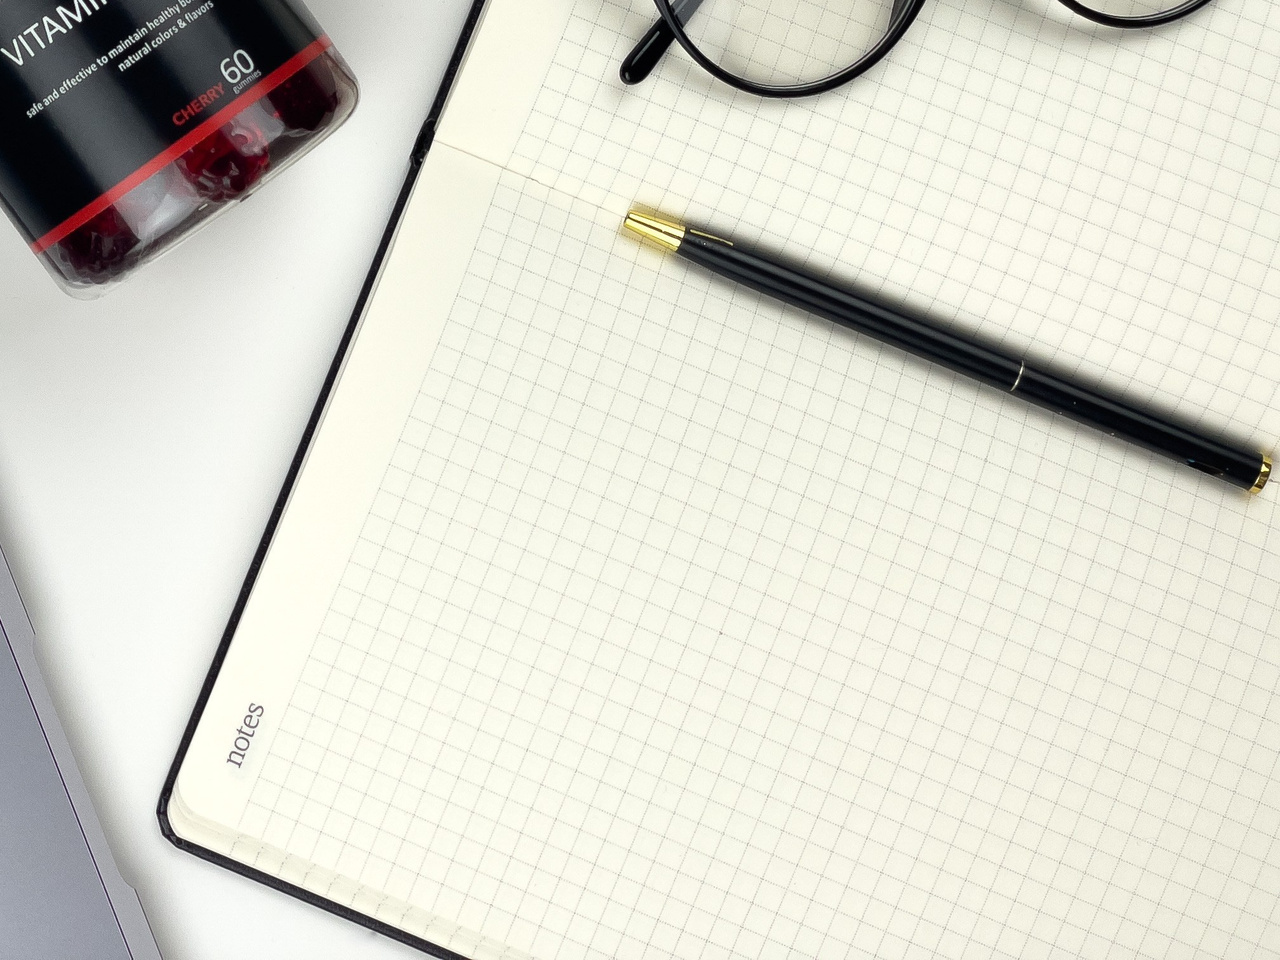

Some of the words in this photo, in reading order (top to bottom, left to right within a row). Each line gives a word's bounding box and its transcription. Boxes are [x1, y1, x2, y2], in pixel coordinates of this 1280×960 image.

[26, 103, 44, 119] safe
[42, 88, 60, 107] and
[59, 63, 98, 94] effective
[96, 55, 108, 67] to
[108, 27, 149, 59] maintain
[146, 4, 181, 31] healthy
[118, 42, 152, 72] natural
[151, 25, 179, 48] colors
[176, 18, 187, 29] &
[184, 0, 214, 23] flavors
[172, 82, 225, 126] CHERRY
[220, 49, 254, 83] 60
[232, 69, 262, 95] gummies
[226, 702, 264, 768] notes
